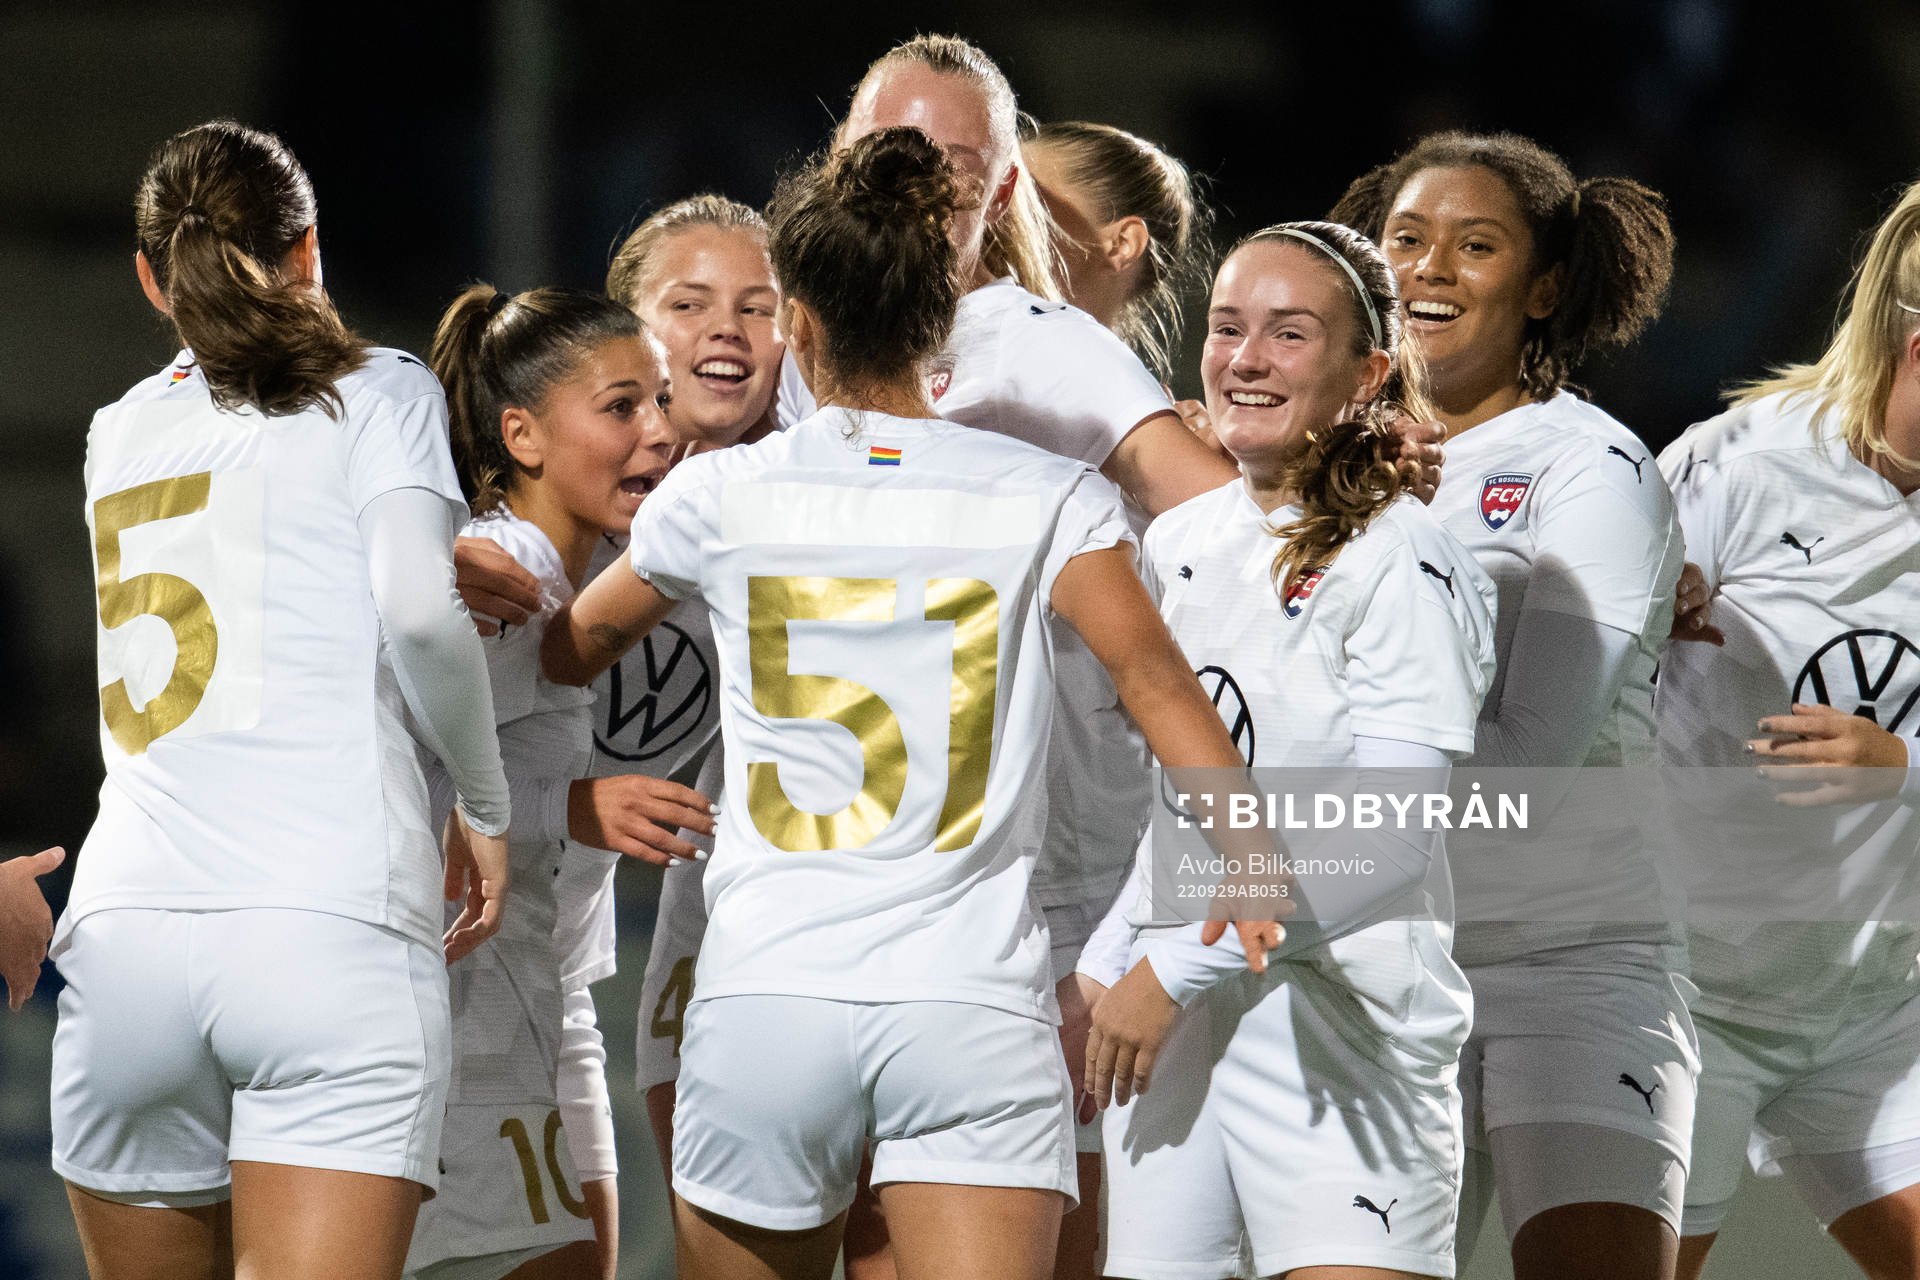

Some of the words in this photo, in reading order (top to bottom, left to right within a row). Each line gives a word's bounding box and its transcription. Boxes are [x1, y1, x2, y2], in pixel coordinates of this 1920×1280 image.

[1485, 487, 1526, 503] FCR
[94, 471, 218, 755] 5
[747, 576, 999, 853] 51
[652, 956, 696, 1058] 4
